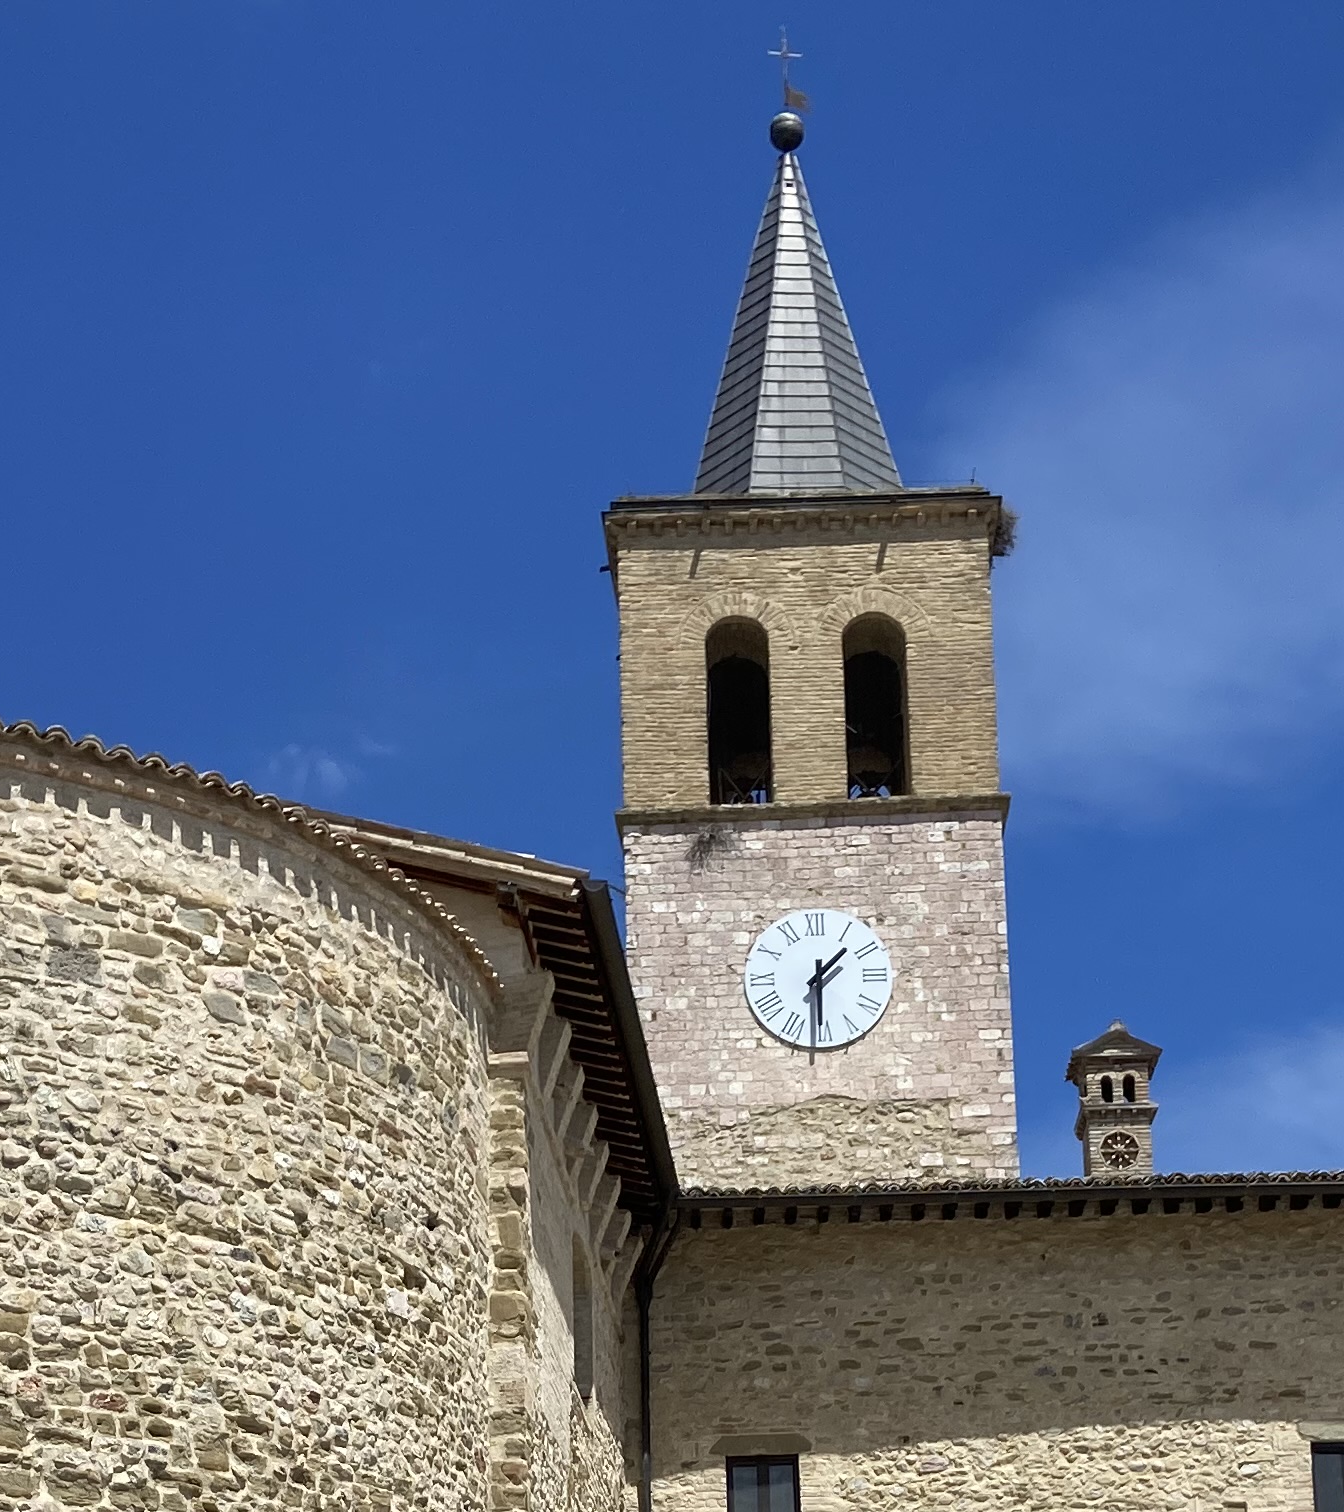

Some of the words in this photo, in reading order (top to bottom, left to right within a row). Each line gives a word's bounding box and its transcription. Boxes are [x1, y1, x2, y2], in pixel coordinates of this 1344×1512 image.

[776, 920, 801, 946] XI
[805, 913, 825, 936] XII
[838, 921, 853, 942] I
[756, 943, 782, 961] X
[854, 941, 879, 960] II
[750, 972, 775, 987] IX
[862, 967, 887, 983] III
[754, 989, 785, 1023] VIII
[856, 993, 882, 1017] IV
[781, 1011, 806, 1040] VII
[842, 1013, 860, 1035] V
